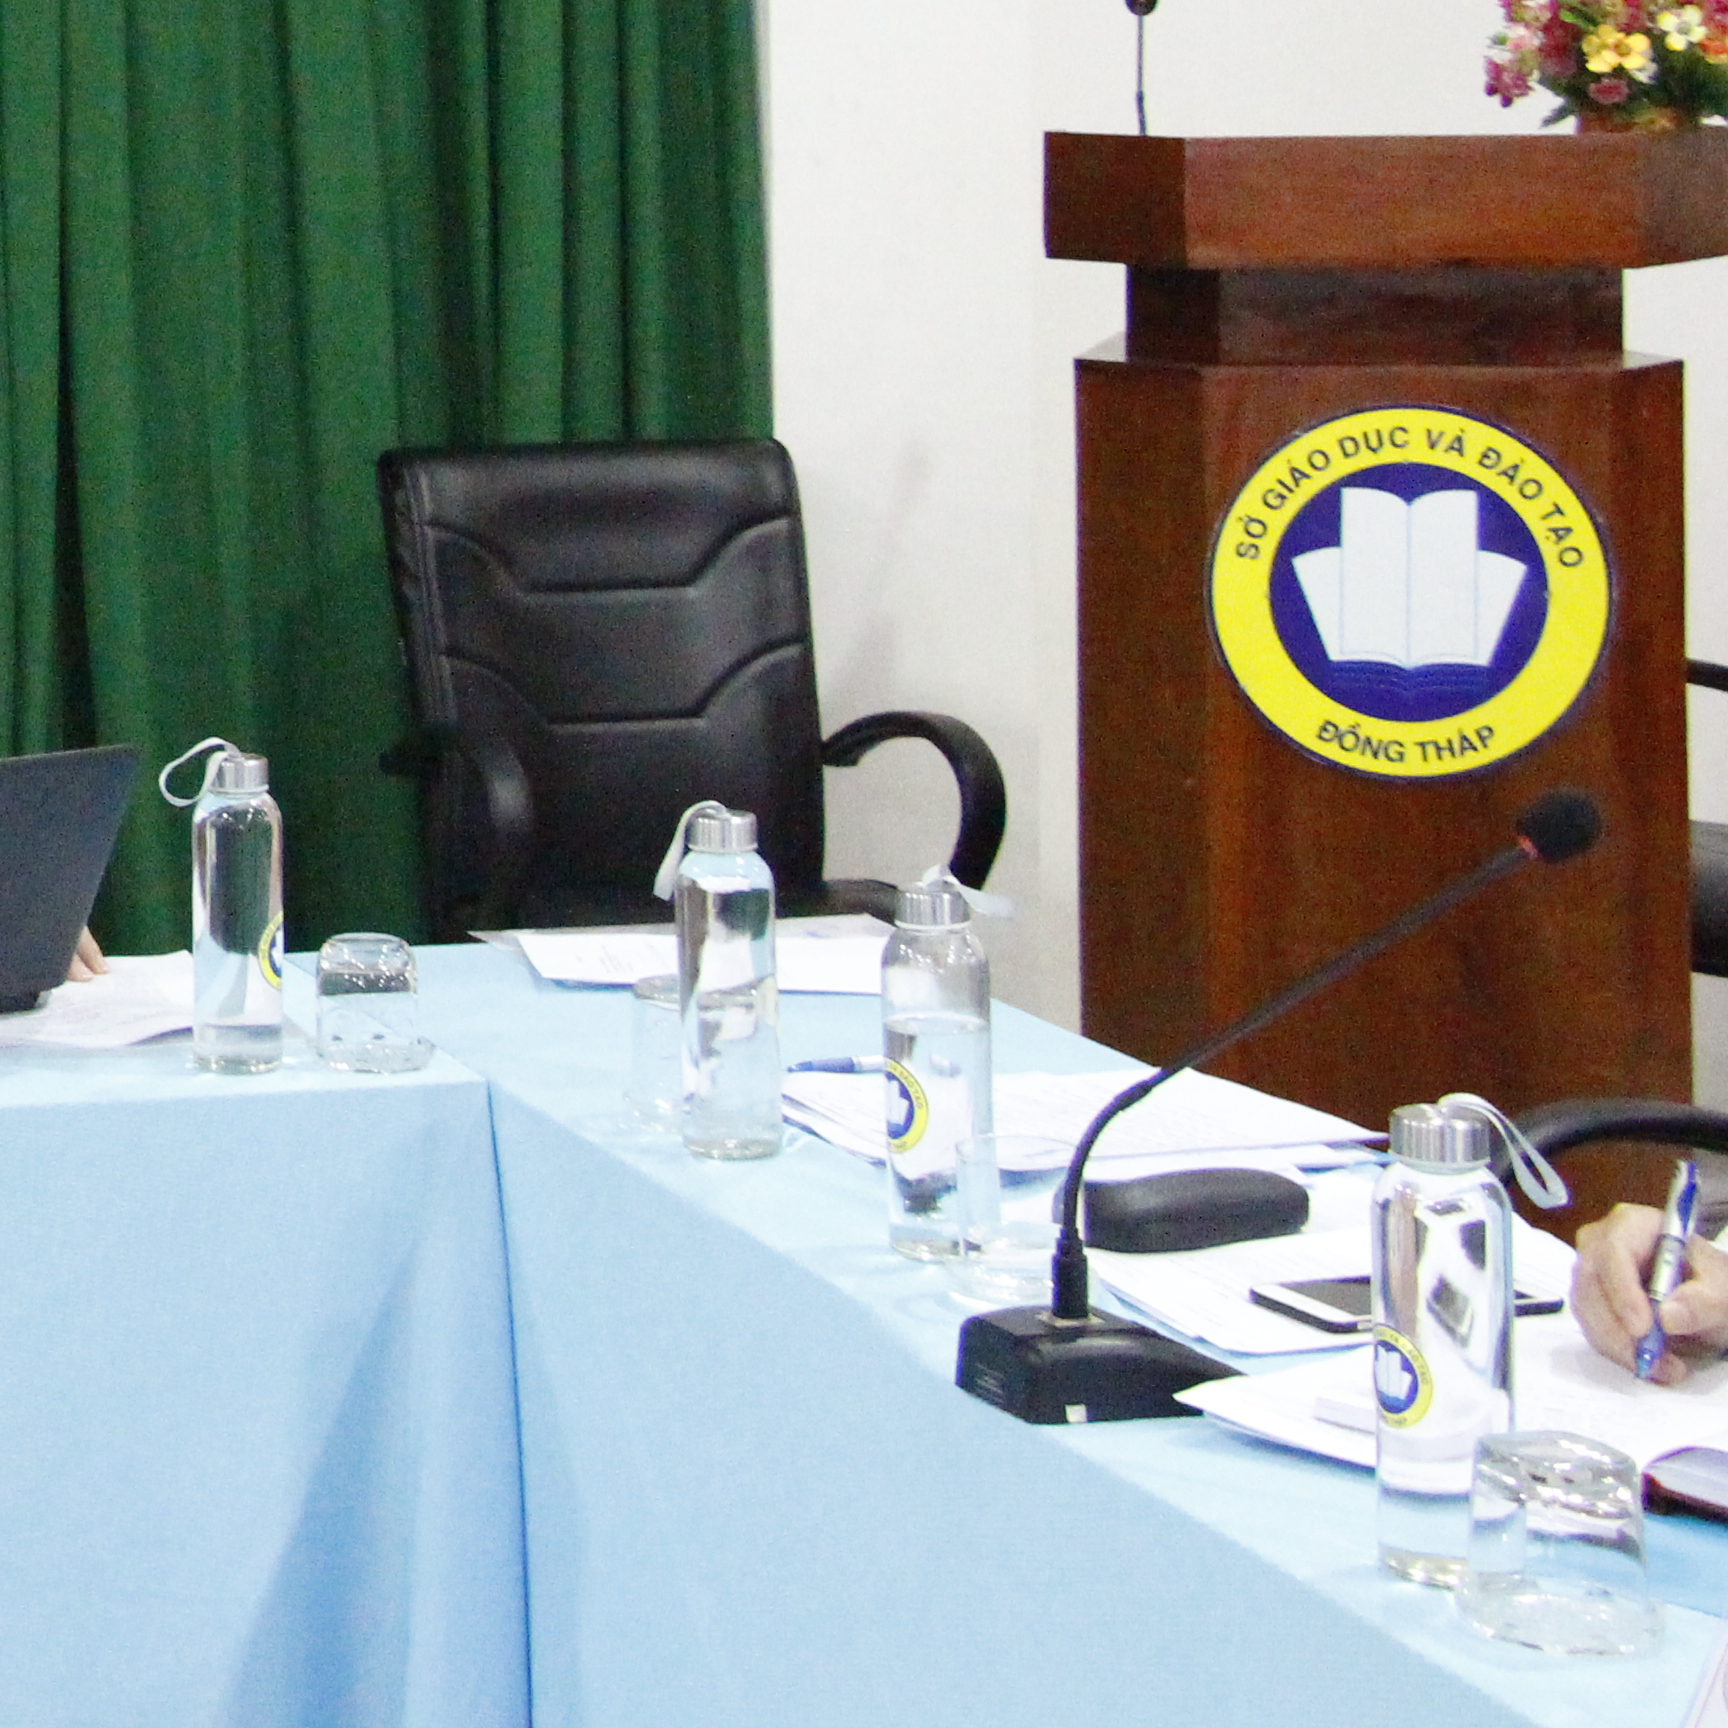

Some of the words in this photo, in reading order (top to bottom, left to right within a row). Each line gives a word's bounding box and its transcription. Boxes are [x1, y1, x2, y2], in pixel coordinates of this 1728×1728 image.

[1236, 514, 1268, 560] SỞ
[1263, 447, 1331, 511] GIÁO
[1339, 426, 1410, 458] DỤC
[1424, 427, 1466, 458] VÀ
[1478, 447, 1544, 501] ĐÀO
[1544, 502, 1584, 569] TẠO
[1315, 719, 1405, 763] ĐỒNG
[1416, 724, 1496, 764] THÁP
